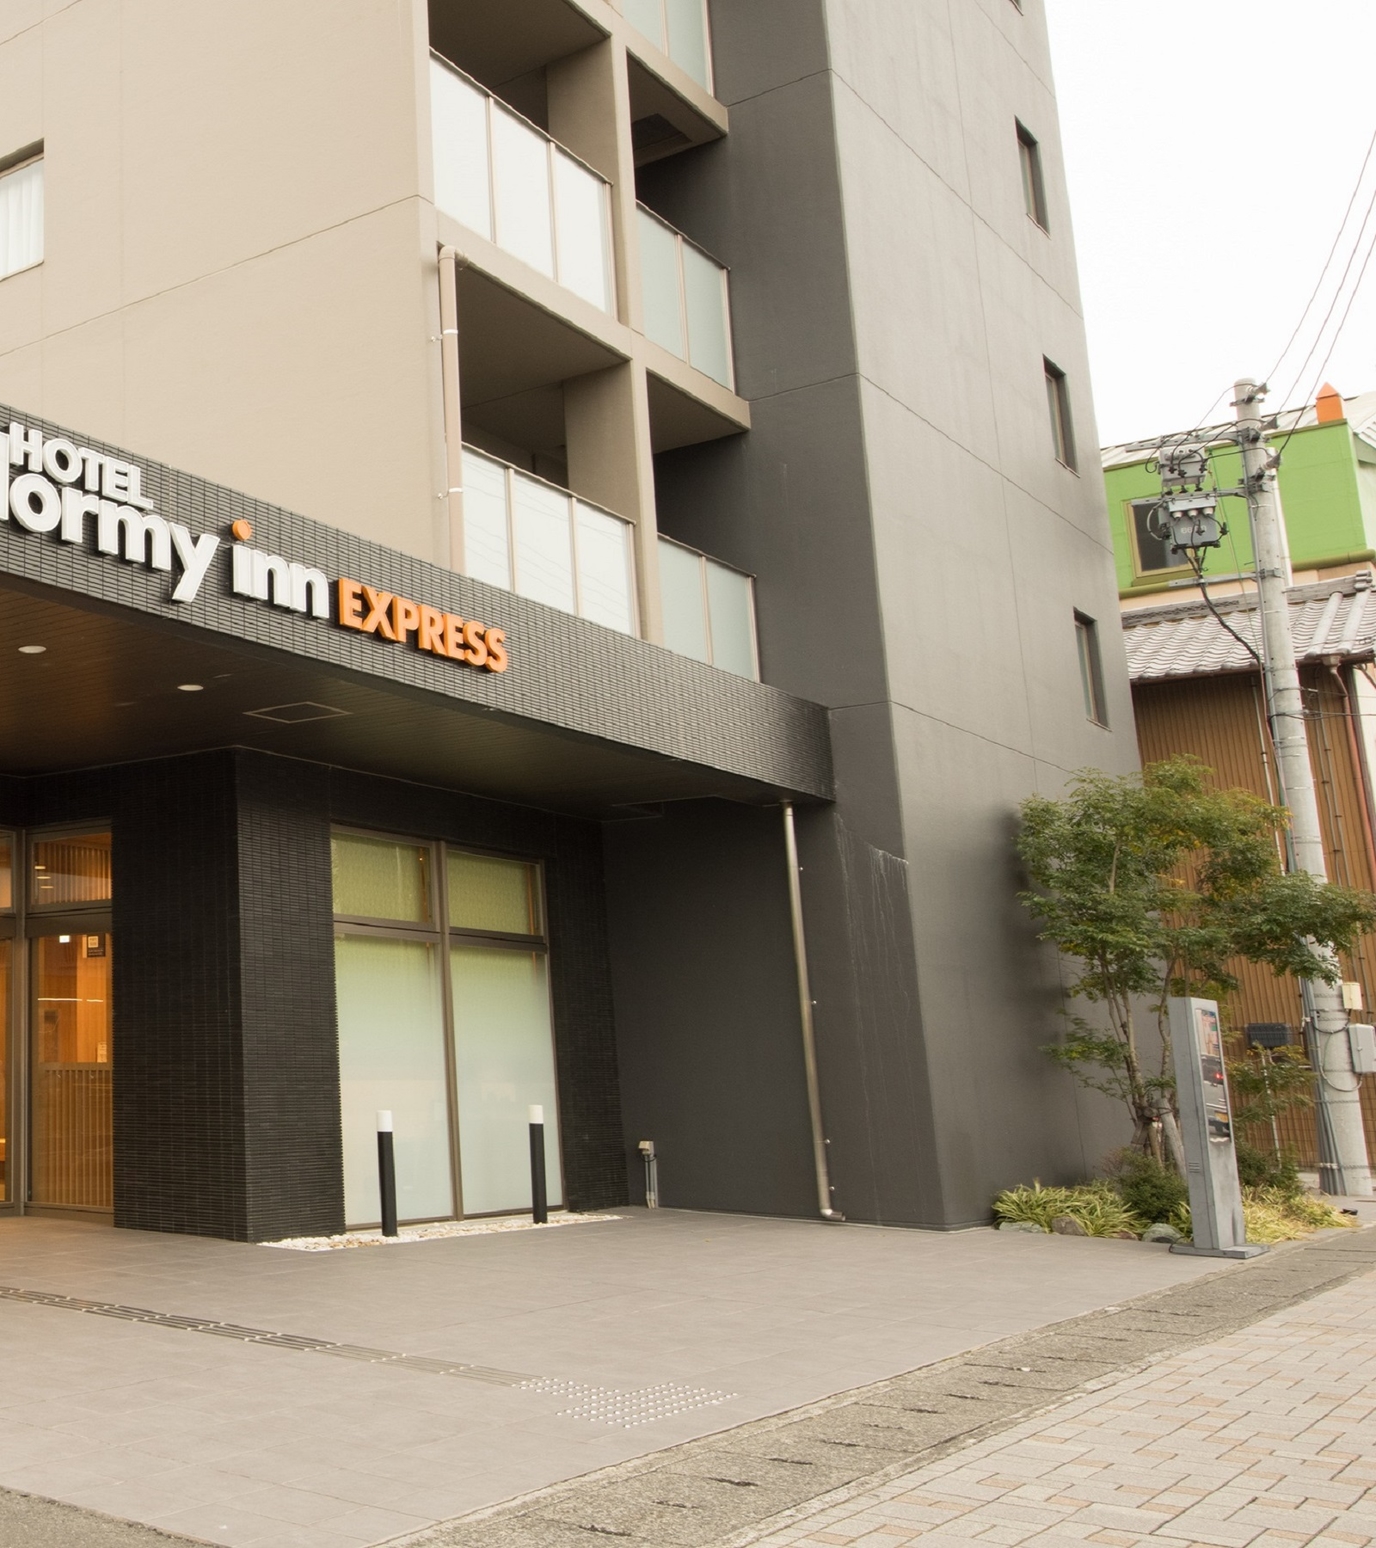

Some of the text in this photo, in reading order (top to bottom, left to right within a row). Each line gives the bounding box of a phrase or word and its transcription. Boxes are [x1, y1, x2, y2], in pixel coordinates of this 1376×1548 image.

[10, 422, 153, 510] HOTEL
[231, 519, 330, 619] inn
[338, 577, 508, 673] EXPRESS
